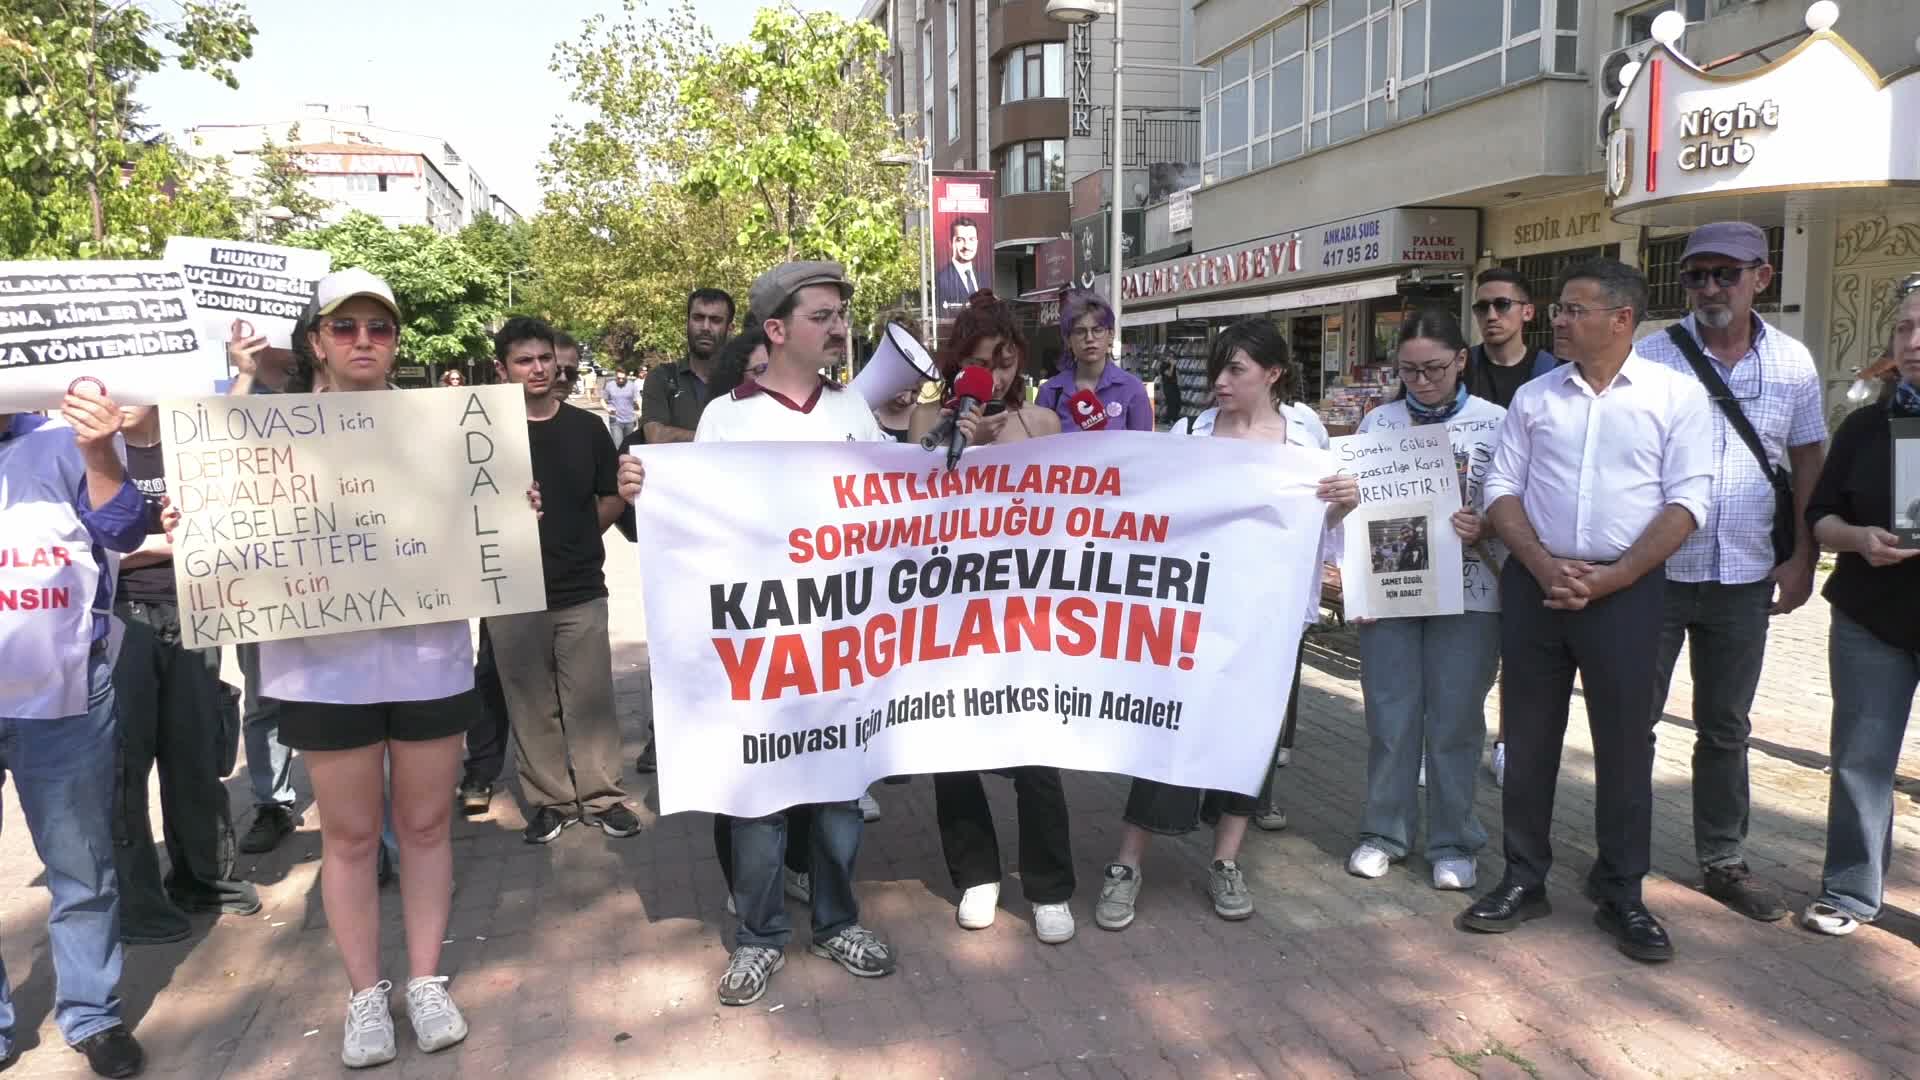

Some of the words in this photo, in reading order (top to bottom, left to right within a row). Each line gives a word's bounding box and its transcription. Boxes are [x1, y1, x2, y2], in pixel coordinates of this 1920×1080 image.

[1075, 22, 1091, 131] LVAR
[1678, 99, 1779, 139] Night
[1678, 137, 1755, 171] Club
[1323, 222, 1358, 246] ANKARA
[1412, 235, 1456, 247] PALME
[1514, 215, 1560, 245] SEDİR
[216, 250, 284, 270] HUKUK
[1121, 266, 1180, 300] PALME
[1182, 232, 1302, 290] KİTABEVİ
[1323, 248, 1343, 267] 417
[1347, 245, 1361, 263] 95
[1365, 242, 1379, 260] 28
[1402, 247, 1465, 261] KİTABEVİ
[185, 267, 260, 288] UÇLUYU
[262, 276, 314, 296] DEĞİL
[54, 302, 138, 323] KİMLER
[139, 299, 184, 321] İÇİN
[31, 331, 194, 362] YÖNTEMİDİR?
[172, 403, 326, 445] DİLOVASI
[176, 444, 295, 482] DEPREM
[178, 474, 319, 514] DAVALARI
[832, 464, 1122, 508] KATLİAMLARDA
[182, 502, 337, 547] AKBELEN
[788, 497, 1055, 564] SORUMLULUĞU
[1066, 505, 1170, 543] OLAN
[185, 532, 378, 578] GAYRETTEPE
[188, 575, 248, 612] İLİÇ
[709, 567, 873, 631] KAMU
[888, 541, 1211, 605] GÖREVLİLERİ
[1381, 577, 1402, 586] SAMET
[1399, 588, 1422, 597] ADALET
[191, 587, 406, 645] KARTALKAYA
[711, 595, 1202, 702] YARGILANSIN!
[742, 723, 847, 765] Dilovası
[855, 708, 882, 752] için
[885, 688, 956, 729] Adalet
[963, 684, 1050, 717] Herkes
[1054, 683, 1092, 725] için
[1100, 690, 1183, 731] Adalet!
